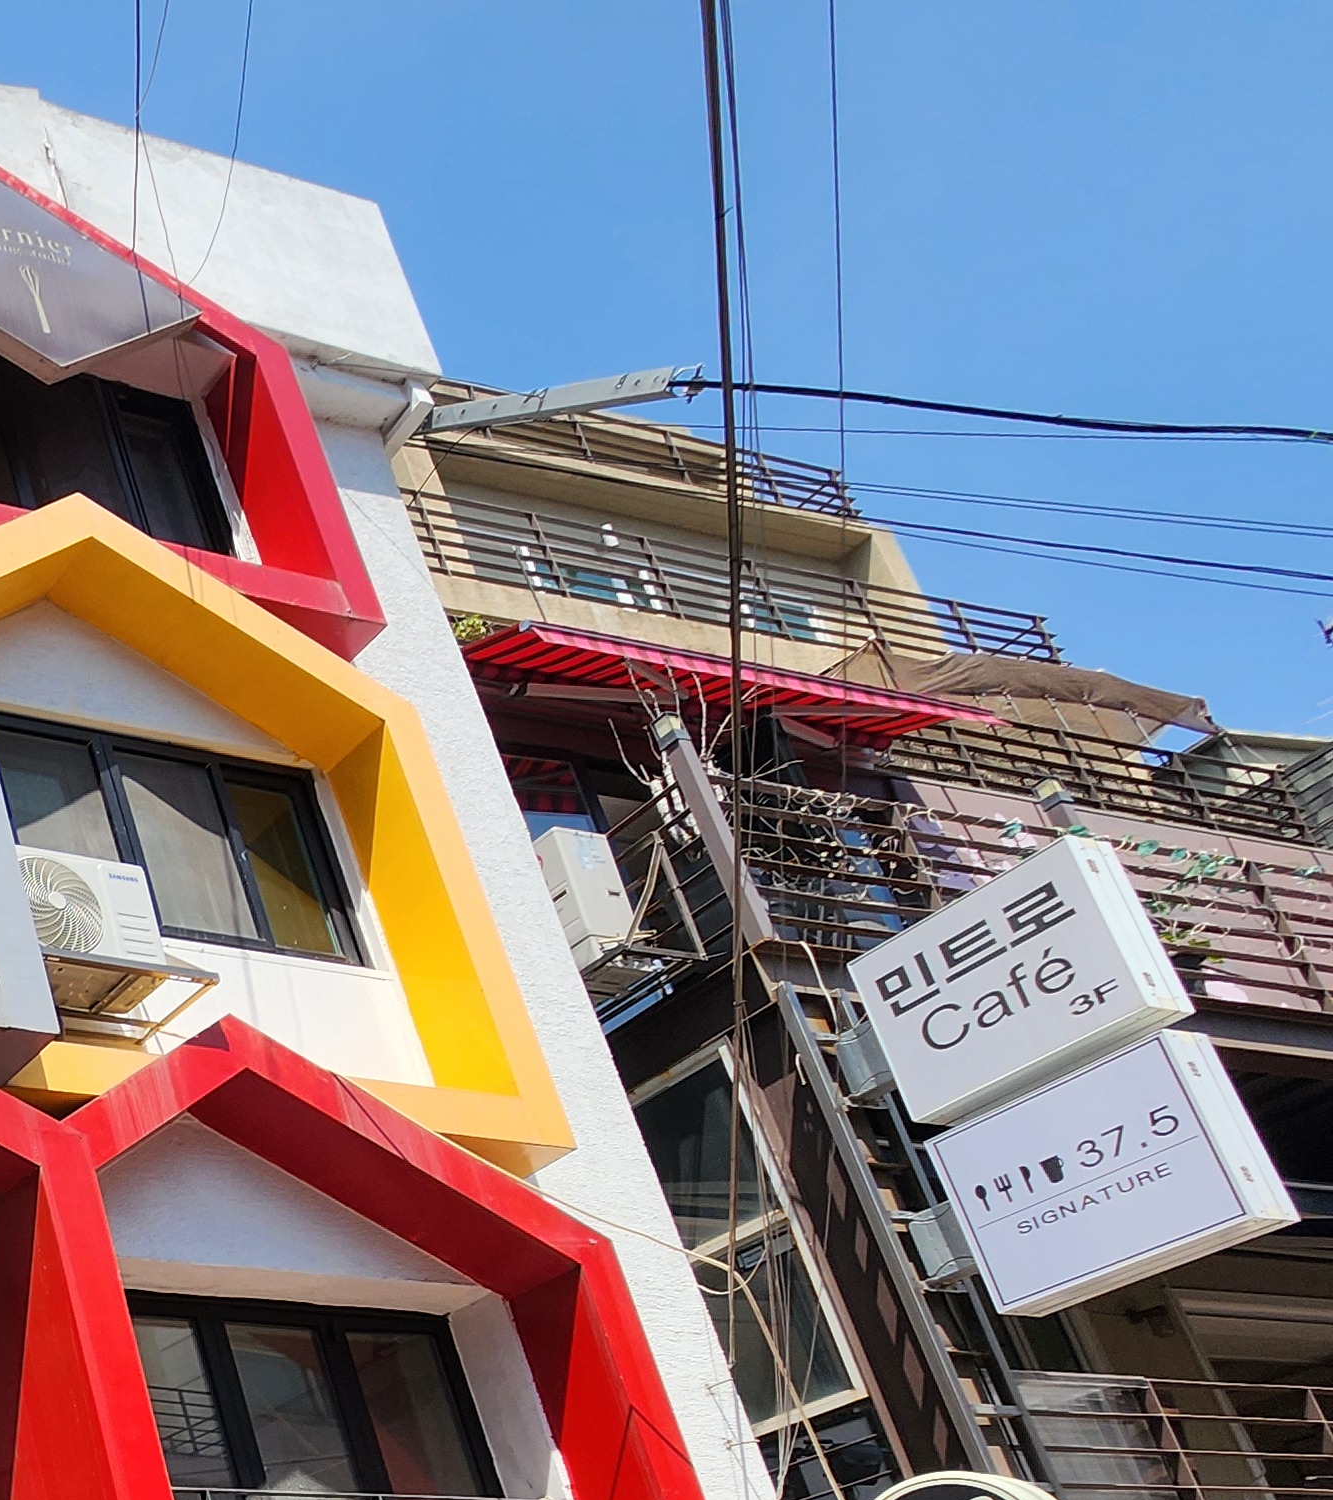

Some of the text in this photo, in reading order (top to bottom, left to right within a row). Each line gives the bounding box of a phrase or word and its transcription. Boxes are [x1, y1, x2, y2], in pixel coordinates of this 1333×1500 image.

[108, 872, 139, 883] SAMSUNG
[874, 880, 1077, 1017] 민트로
[921, 945, 1077, 1053] Café
[1068, 977, 1121, 1018] 3F
[1076, 1104, 1180, 1169] 37.5
[1017, 1161, 1173, 1237] SIGNATURE
